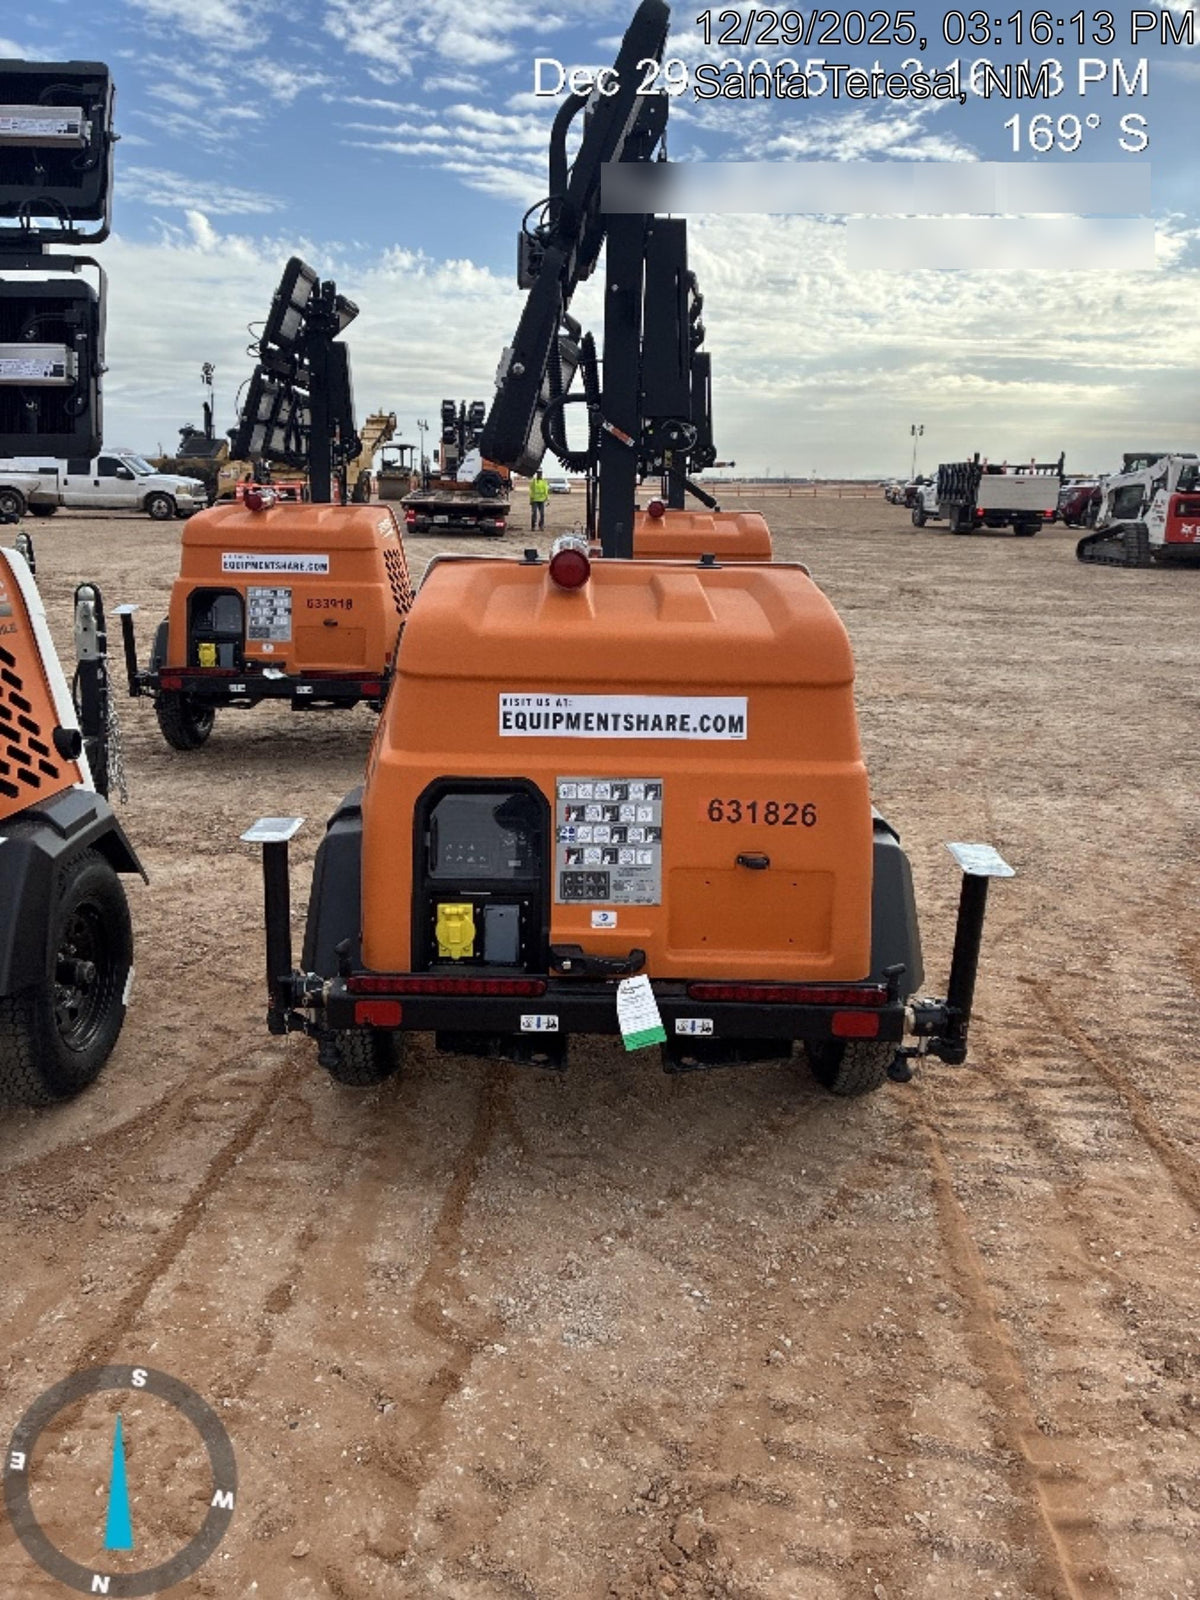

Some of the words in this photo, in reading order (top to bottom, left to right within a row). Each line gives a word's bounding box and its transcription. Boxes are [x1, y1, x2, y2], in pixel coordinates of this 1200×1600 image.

[502, 698, 533, 707] VISIT
[536, 698, 550, 706] US
[502, 711, 745, 735] EQUIPMENTSHARE.COM
[707, 799, 818, 827] 631826
